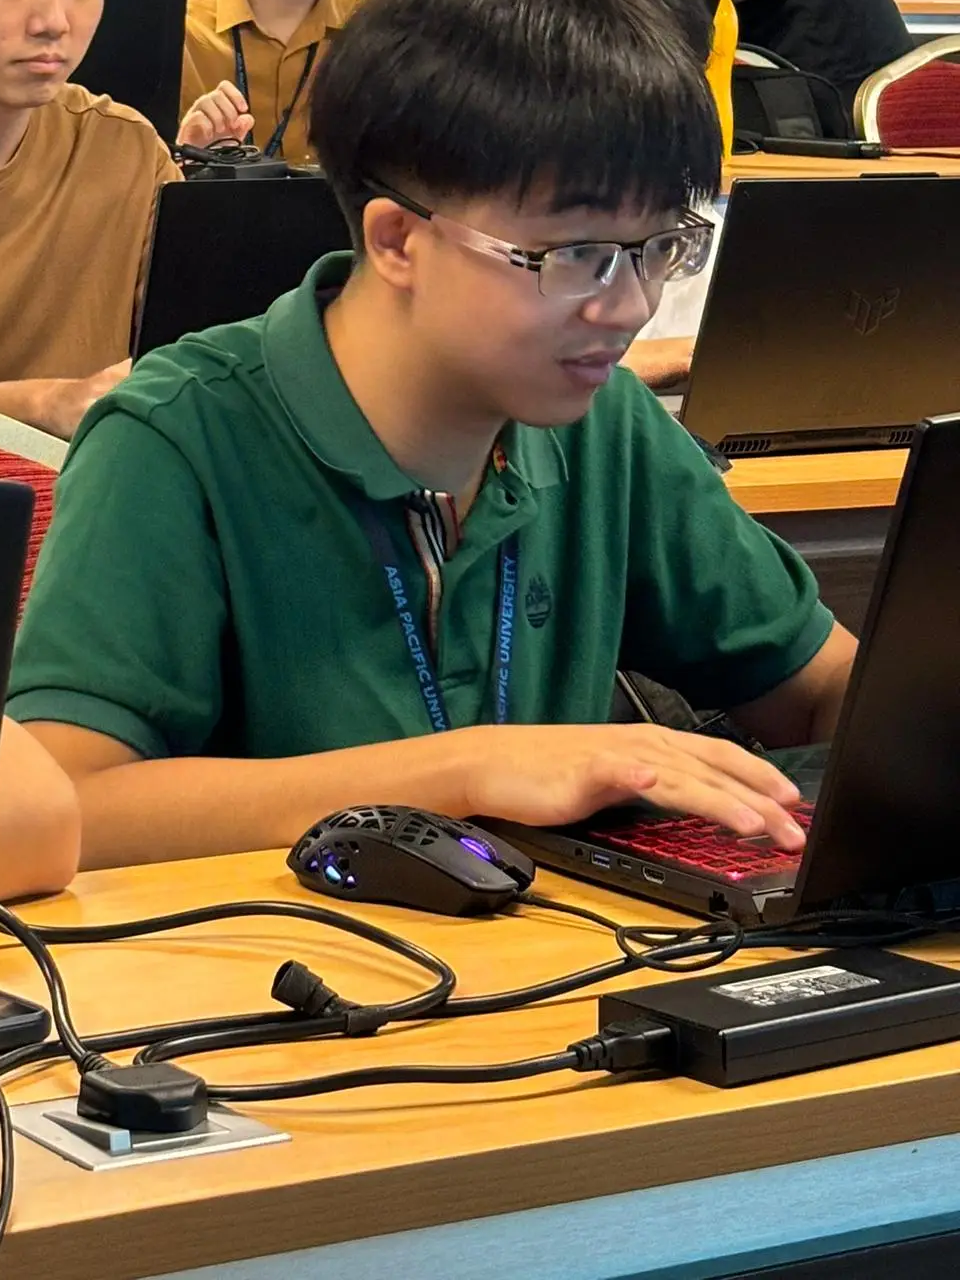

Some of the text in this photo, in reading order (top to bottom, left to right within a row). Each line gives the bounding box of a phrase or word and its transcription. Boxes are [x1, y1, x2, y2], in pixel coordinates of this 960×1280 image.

[383, 564, 446, 730] ASIA PACIFIC UNIV
[496, 556, 517, 724] CIFIC UNIVERSITY
